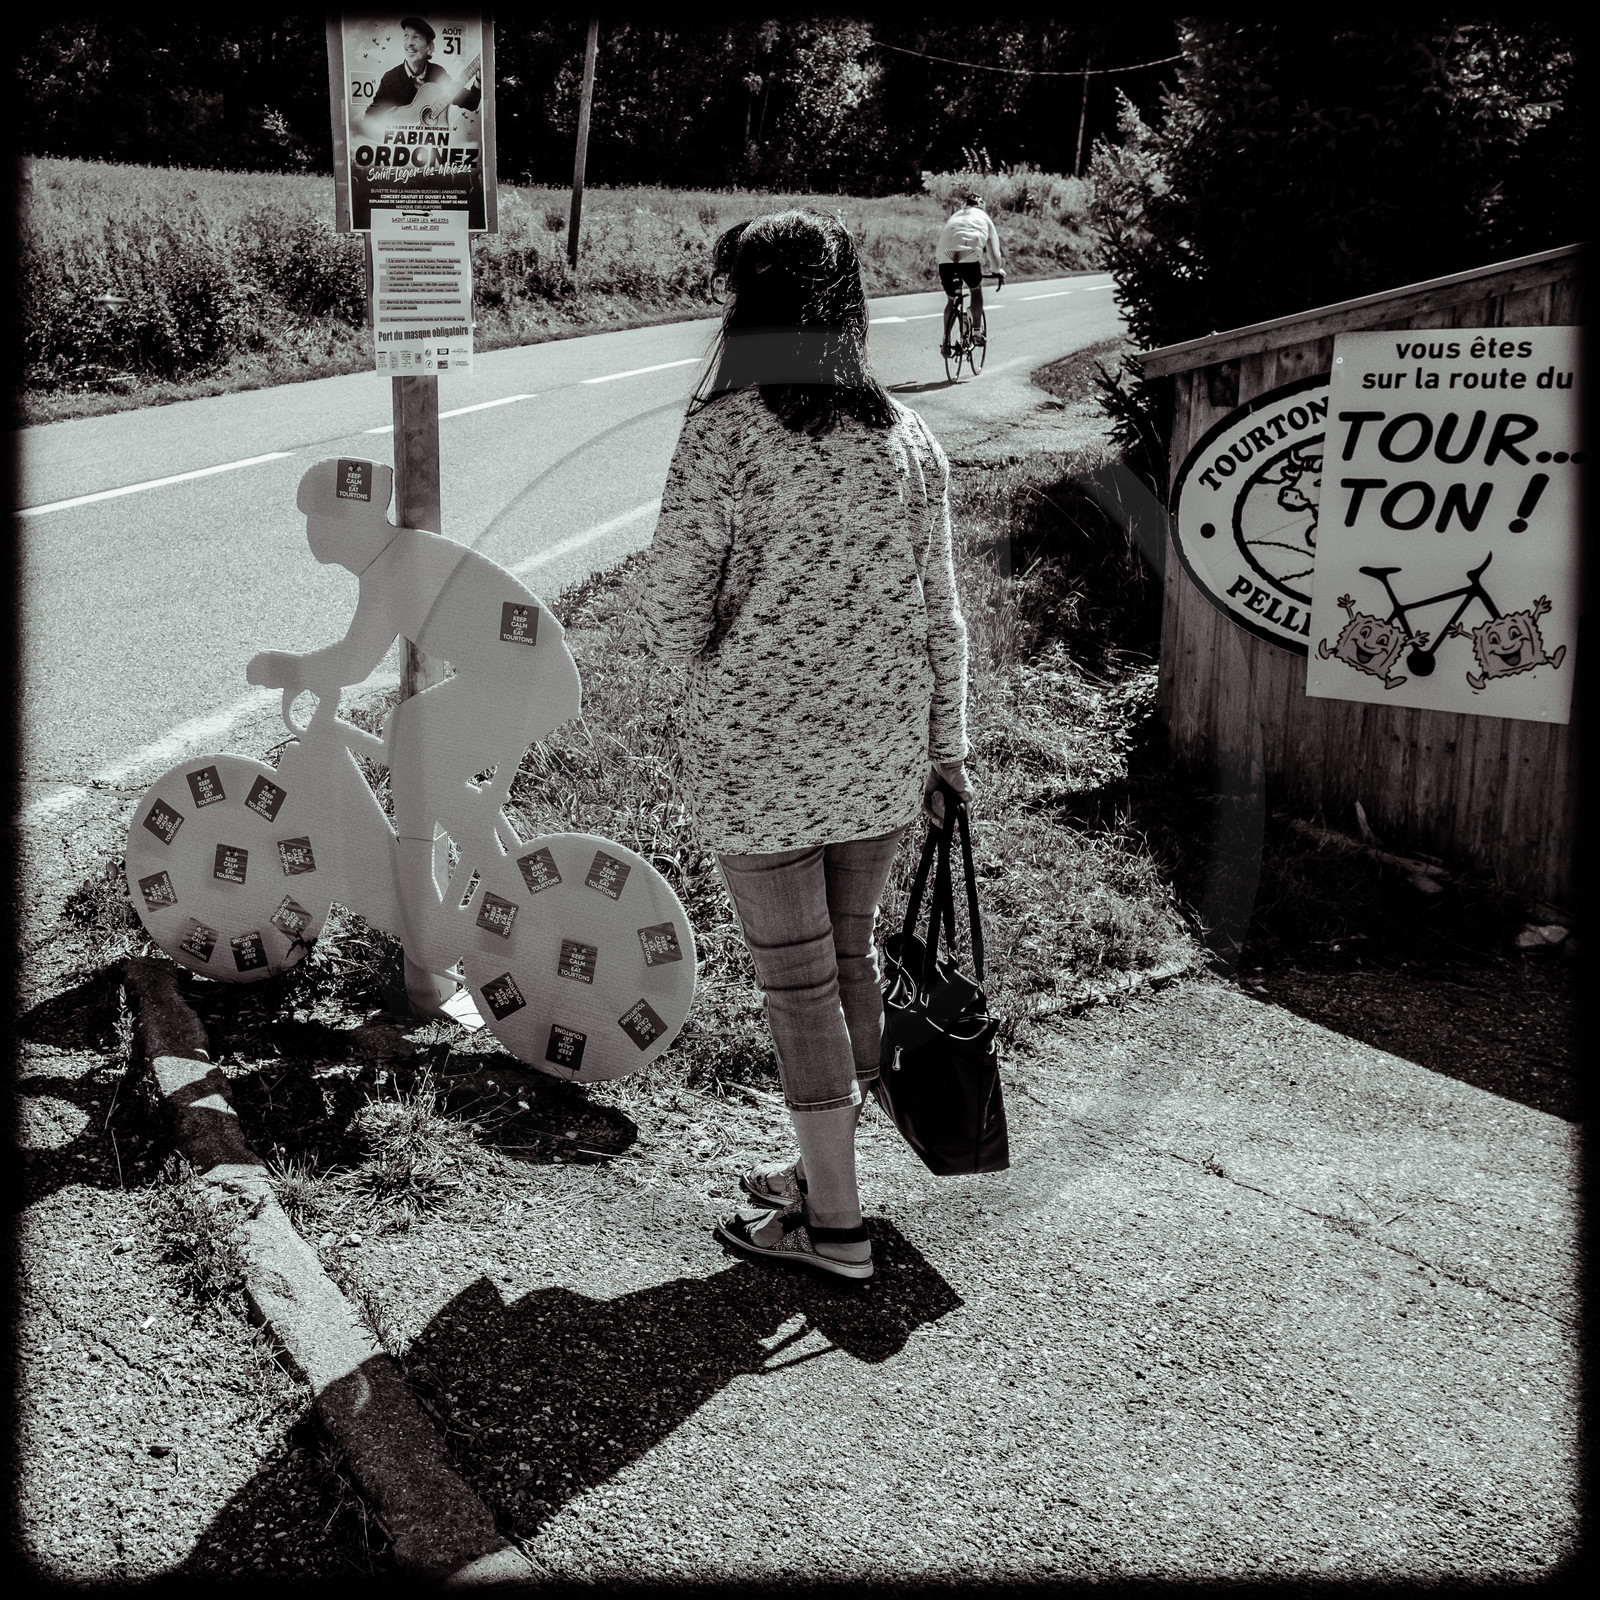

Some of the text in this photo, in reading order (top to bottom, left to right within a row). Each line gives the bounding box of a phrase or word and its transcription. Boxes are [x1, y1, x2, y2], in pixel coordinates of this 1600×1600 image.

[442, 27, 462, 35] AOÛT
[443, 37, 461, 55] 31
[384, 130, 450, 146] FABIAN
[378, 325, 468, 342] Port du masque obligatoire
[1396, 336, 1533, 359] vous êtes
[1362, 366, 1573, 390] sur la route du
[1338, 409, 1587, 466] TOUR...
[346, 478, 362, 486] CALM
[339, 491, 368, 500] TOURTONS
[1341, 473, 1549, 533] TON !
[510, 621, 527, 629] CALM
[503, 633, 533, 644] TOURTONS
[199, 779, 211, 787] KEEP
[199, 784, 214, 793] CALM
[197, 793, 223, 806] TOURTONS
[258, 793, 273, 806] CALM
[261, 790, 274, 800] KEEP
[247, 799, 273, 820] TOURTONS
[258, 801, 268, 810] EAT
[156, 813, 165, 825] KEEP
[159, 815, 170, 830] CALM
[165, 821, 173, 832] EAT
[165, 817, 182, 843] TOURTONS
[279, 844, 291, 874] TOURTONS
[292, 848, 300, 865] CALM
[223, 861, 238, 869] CALM
[531, 862, 544, 872] KEEP
[603, 866, 617, 877] KEEP
[216, 871, 243, 882] TOURTONS
[532, 867, 548, 878] CALM
[538, 875, 548, 883] EAT
[599, 870, 616, 883] CALM
[531, 876, 559, 893] TOURTONS
[587, 879, 618, 899] TOURTONS
[599, 879, 611, 888] EAT
[272, 898, 291, 922] TOURTONS
[489, 907, 497, 921] KEEP
[493, 907, 503, 925] CALM
[284, 911, 296, 925] CALM
[289, 916, 299, 928] KEEP
[502, 906, 517, 937] TOURTONS
[191, 935, 206, 946] CALM
[194, 931, 206, 941] KEEP
[231, 933, 258, 945] TOURTONS
[192, 943, 202, 951] EAT
[639, 931, 654, 965] TOURTONS
[648, 941, 656, 953] EAT
[654, 935, 664, 954] CALM
[660, 936, 668, 951] KEEP
[182, 943, 208, 961] TOURTONS
[241, 947, 256, 955] CALM
[571, 953, 585, 961] KEEP
[569, 958, 586, 967] CALM
[560, 969, 591, 982] TOURTONS
[571, 966, 582, 974] EAT
[498, 987, 510, 1005] CALM
[504, 974, 524, 1005] TOURTONS
[505, 987, 514, 998] EAT
[494, 991, 505, 1006] KEEP
[621, 1001, 646, 1025] TOURTONS
[632, 1013, 643, 1023] EAT
[634, 1016, 650, 1031] CALM
[640, 1022, 652, 1035] KEEP
[553, 1026, 584, 1041] TOURTONS
[562, 1035, 573, 1043] EAT
[558, 1041, 575, 1051] CALM
[558, 1047, 572, 1056] KEEP
